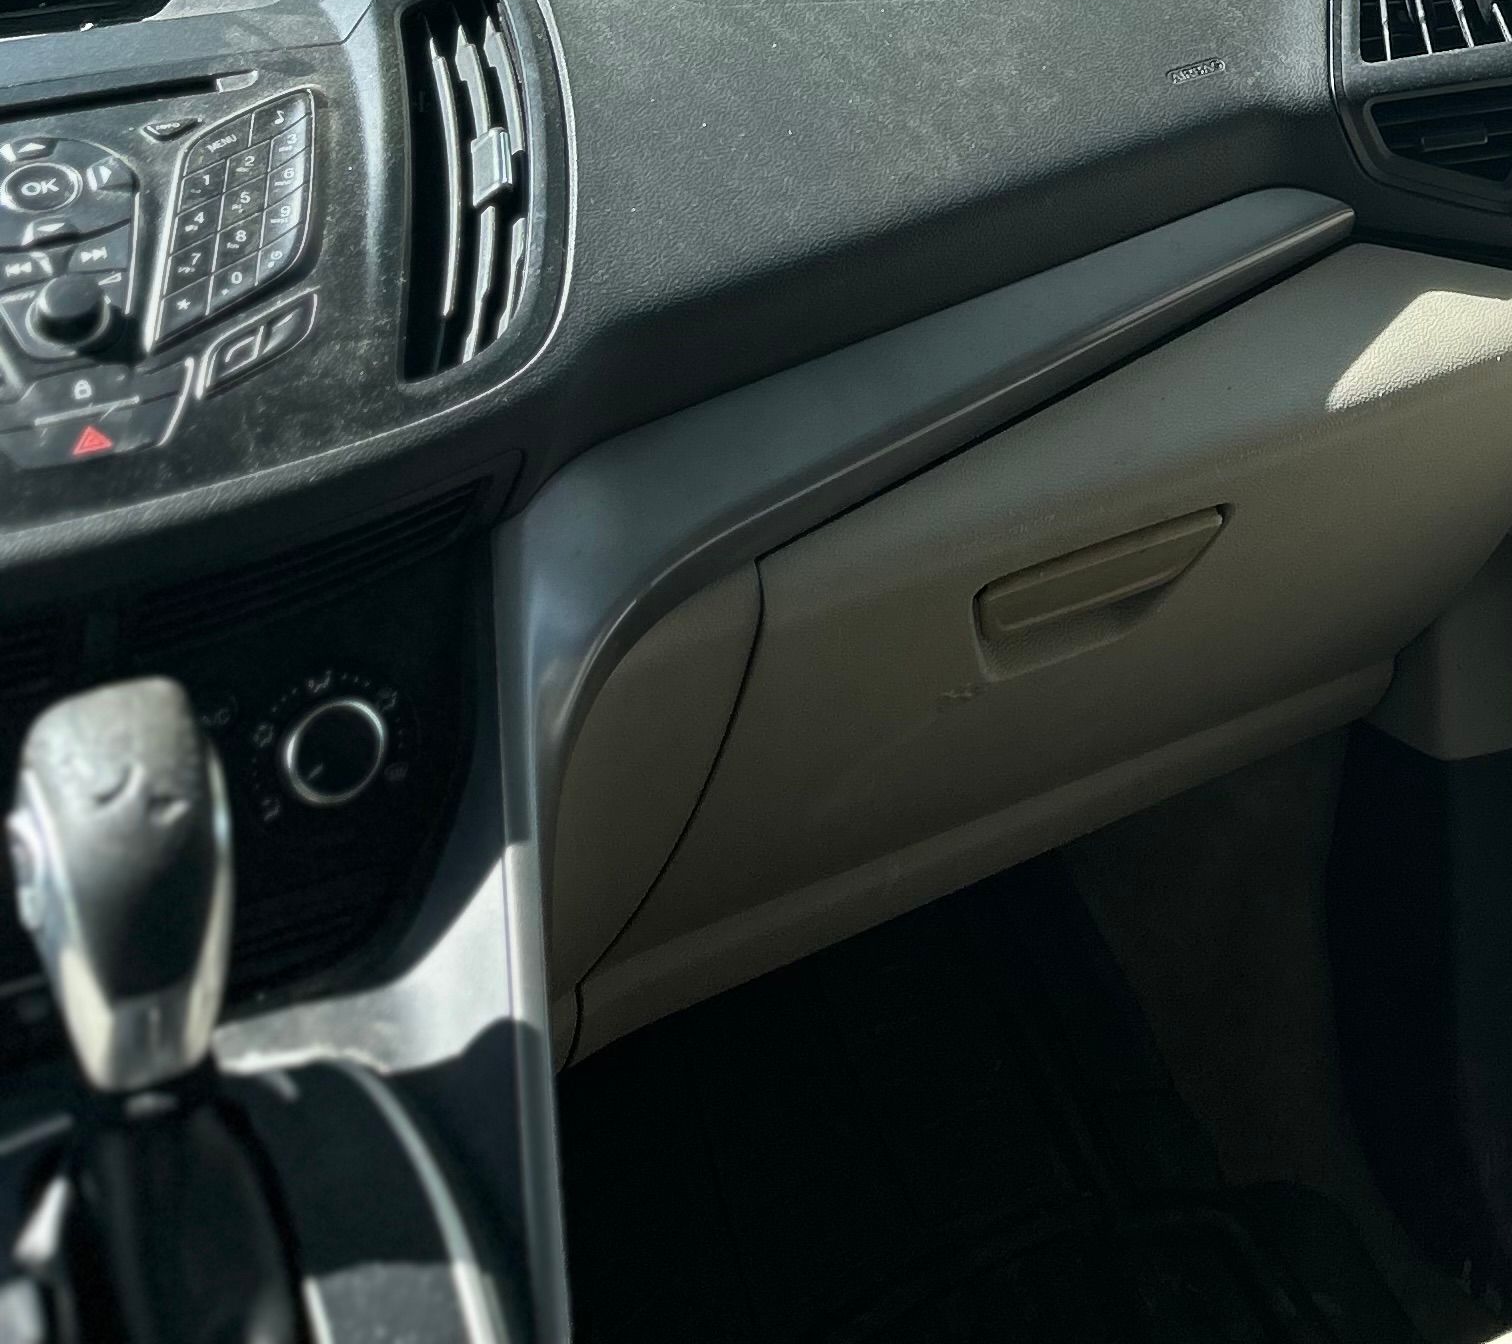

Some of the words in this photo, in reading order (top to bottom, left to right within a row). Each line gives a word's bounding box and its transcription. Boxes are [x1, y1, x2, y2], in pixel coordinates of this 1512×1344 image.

[206, 134, 238, 152] MENU
[286, 133, 298, 145] 3
[244, 155, 256, 167] 2
[283, 167, 295, 179] 6
[202, 174, 211, 186] 1
[21, 178, 59, 196] OK
[239, 191, 251, 204] 5
[194, 211, 205, 224] 4
[280, 205, 292, 217] 9
[235, 229, 247, 242] 8
[191, 252, 202, 266] 7
[231, 271, 243, 285] 0
